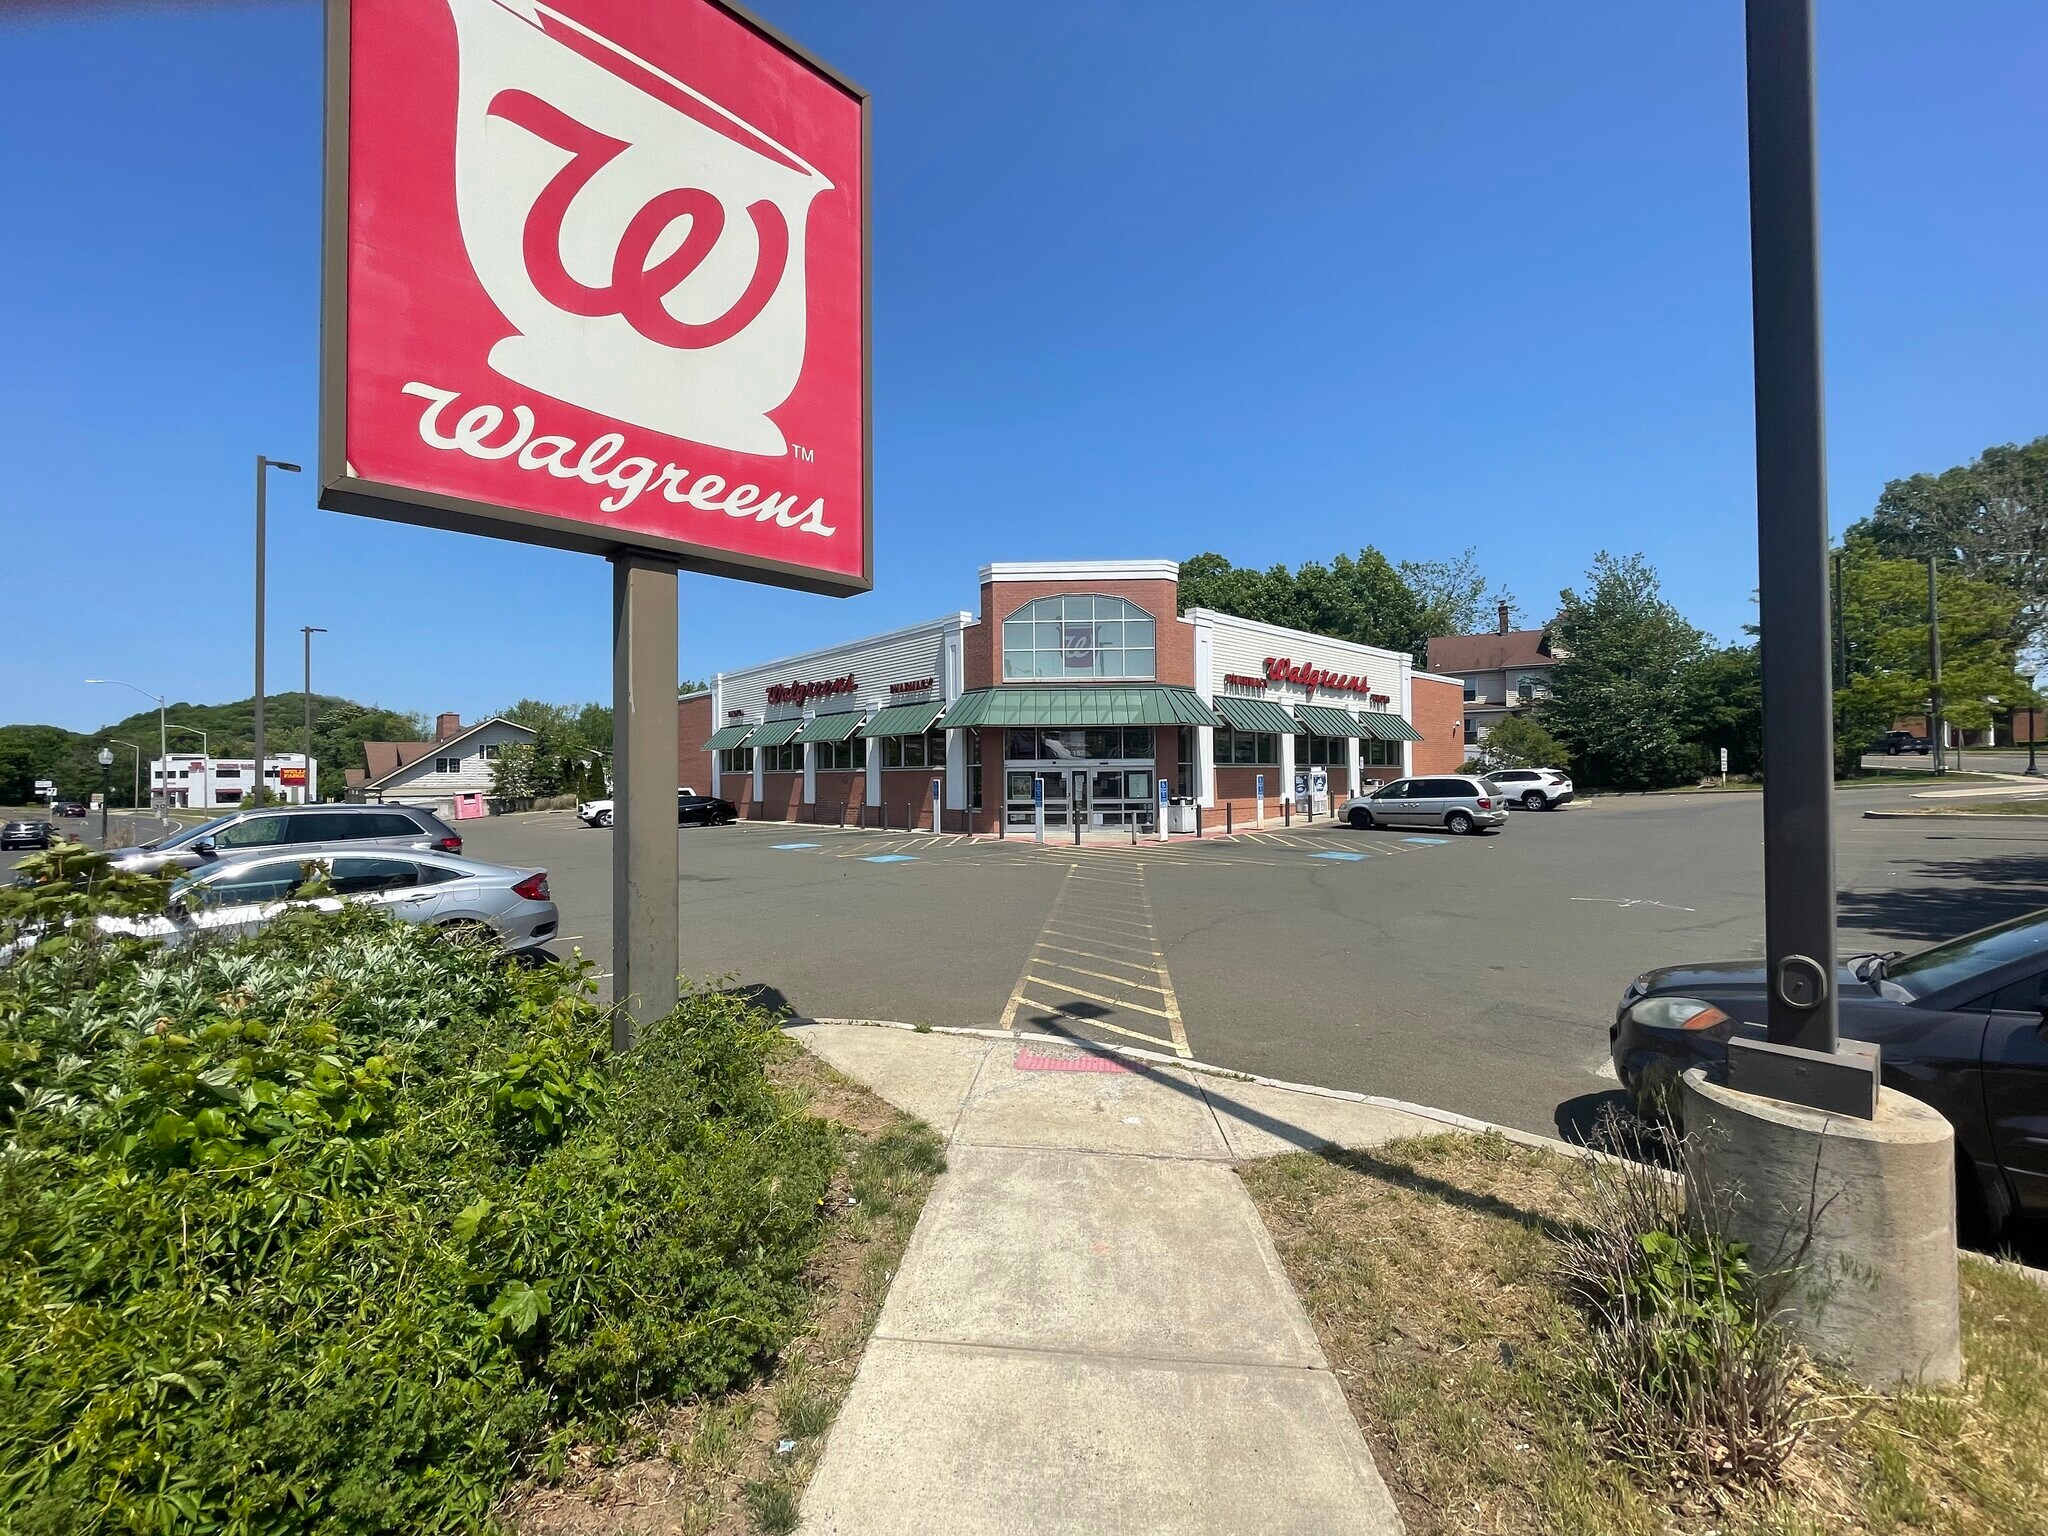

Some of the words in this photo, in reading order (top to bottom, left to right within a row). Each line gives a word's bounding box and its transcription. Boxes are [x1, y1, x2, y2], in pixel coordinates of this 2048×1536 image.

[487, 89, 789, 349] W
[401, 381, 837, 537] Walgreens
[791, 445, 815, 464] TM
[766, 673, 858, 707] Walgreens
[1264, 657, 1371, 694] Walgreens
